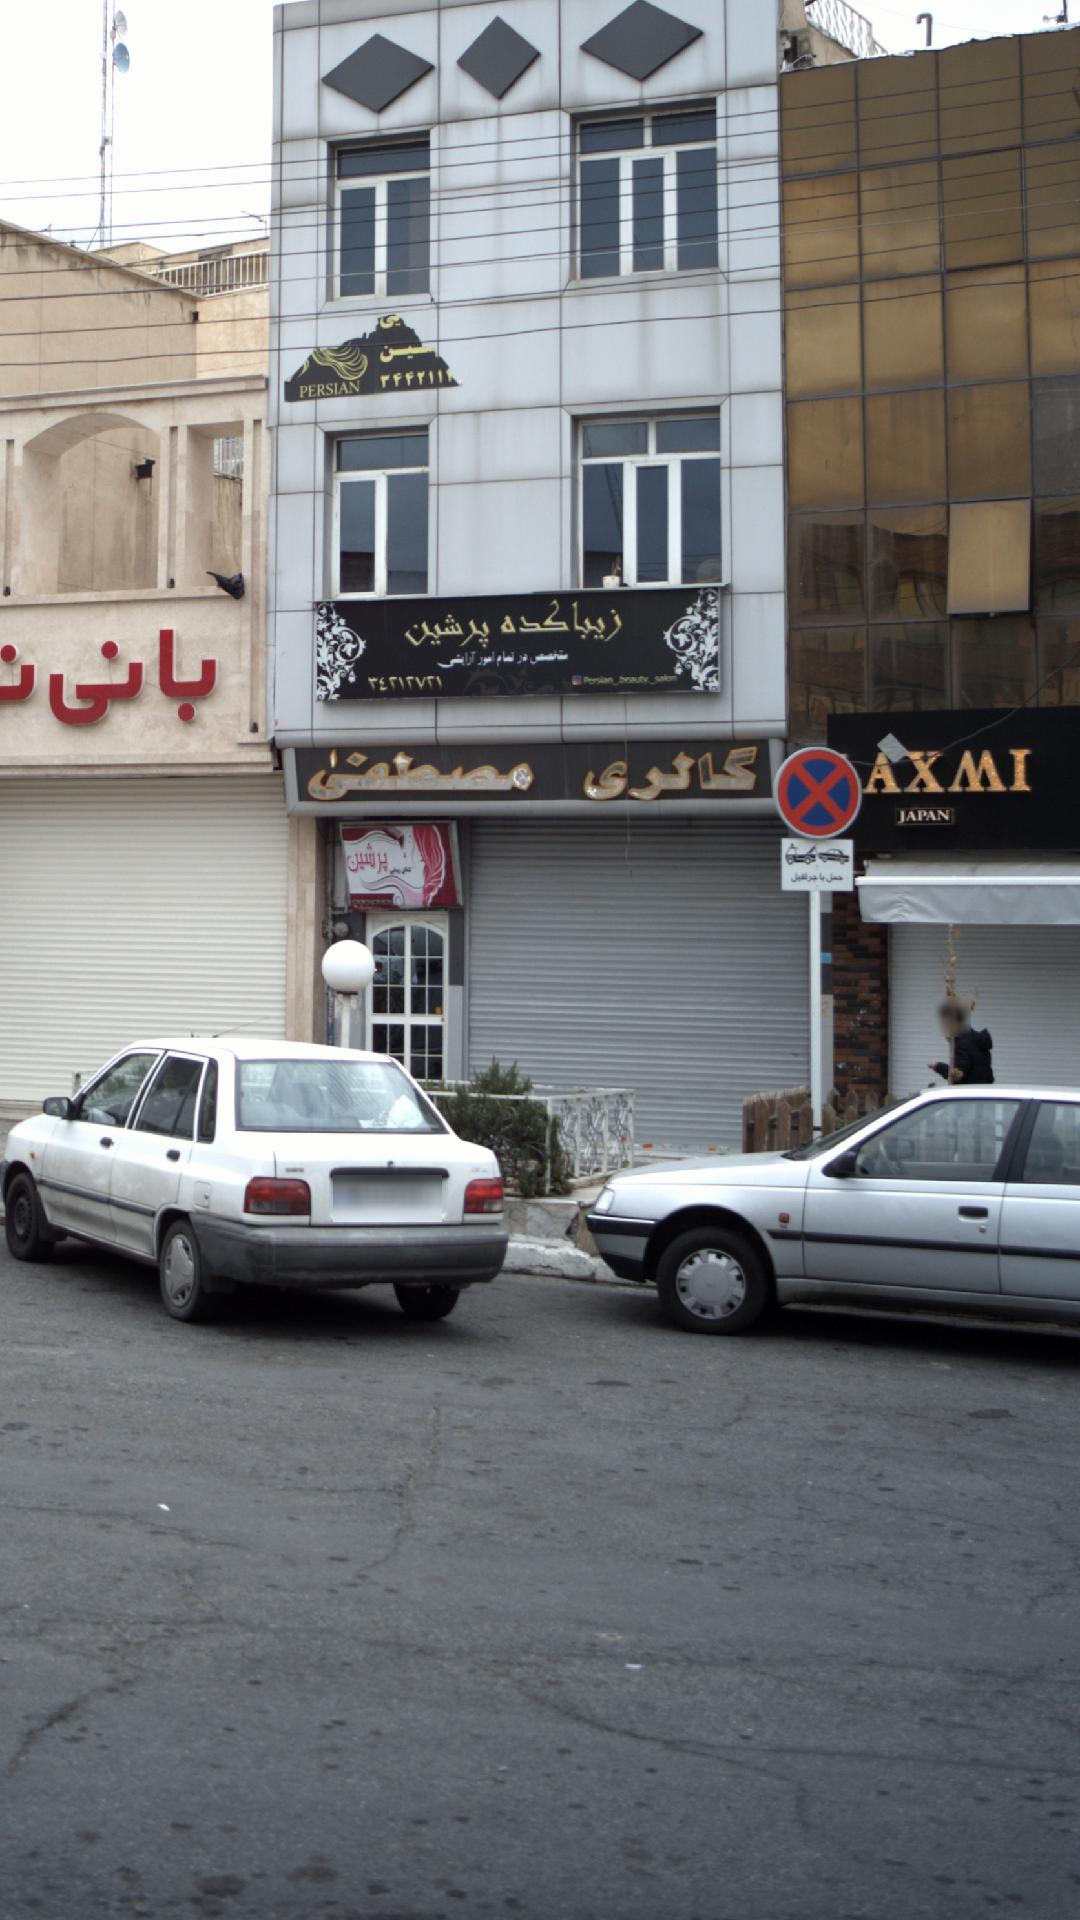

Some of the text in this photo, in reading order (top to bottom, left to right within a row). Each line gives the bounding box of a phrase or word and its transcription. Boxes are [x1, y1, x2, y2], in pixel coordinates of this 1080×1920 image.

[299, 380, 361, 399] PERSIAN
[404, 599, 623, 648] زیباکده پرشین
[436, 651, 476, 668] آرایشی
[477, 651, 494, 666] امور
[496, 650, 515, 667] تمام
[517, 654, 527, 664] در
[584, 746, 758, 801] گالری
[841, 748, 1032, 794] AXMI
[898, 808, 951, 824] JAPAN
[347, 842, 388, 874] پرشین
[819, 872, 825, 882] با
[826, 873, 843, 883] حمل
